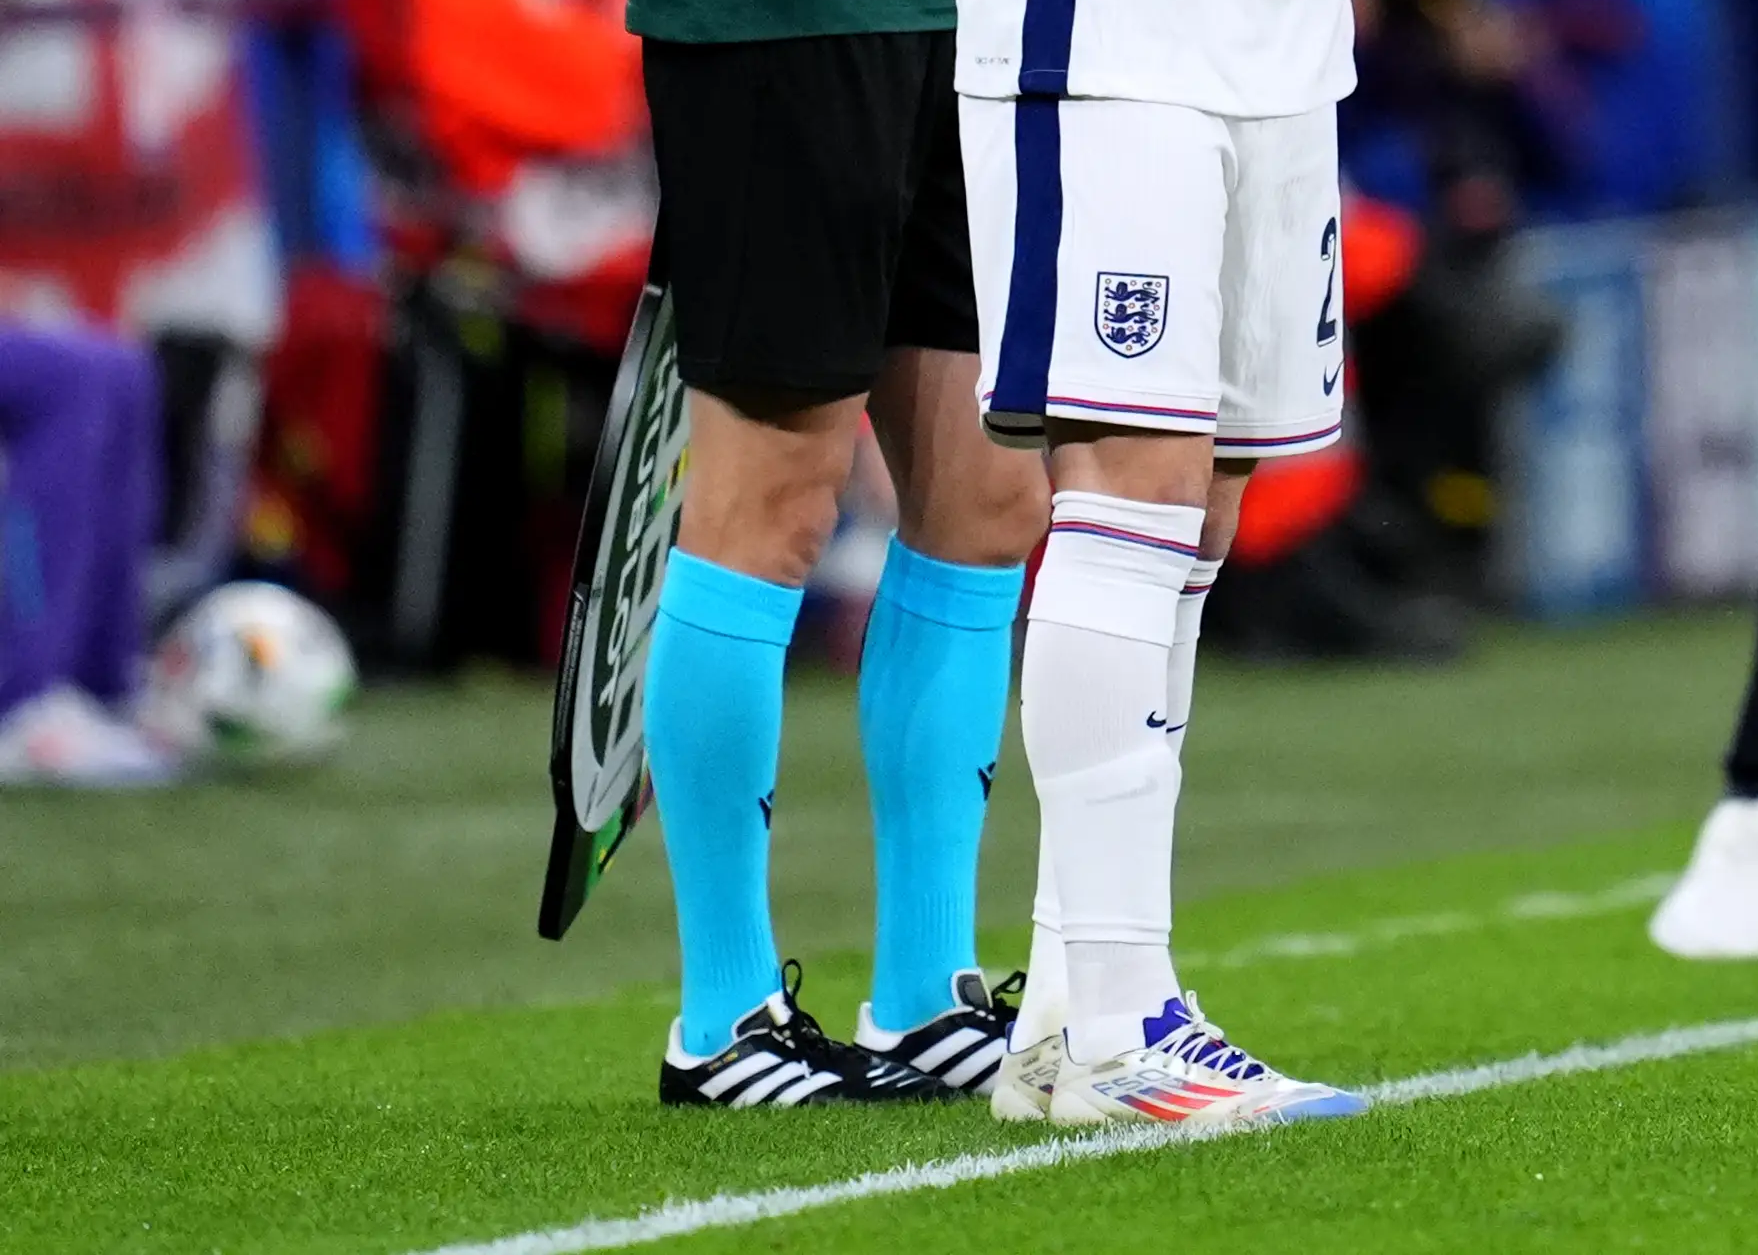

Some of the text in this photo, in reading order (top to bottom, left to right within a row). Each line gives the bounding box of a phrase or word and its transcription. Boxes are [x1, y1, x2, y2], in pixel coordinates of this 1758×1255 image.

[1316, 216, 1338, 347] 2
[599, 344, 672, 707] HUBLOT
[1092, 1068, 1170, 1097] F50
